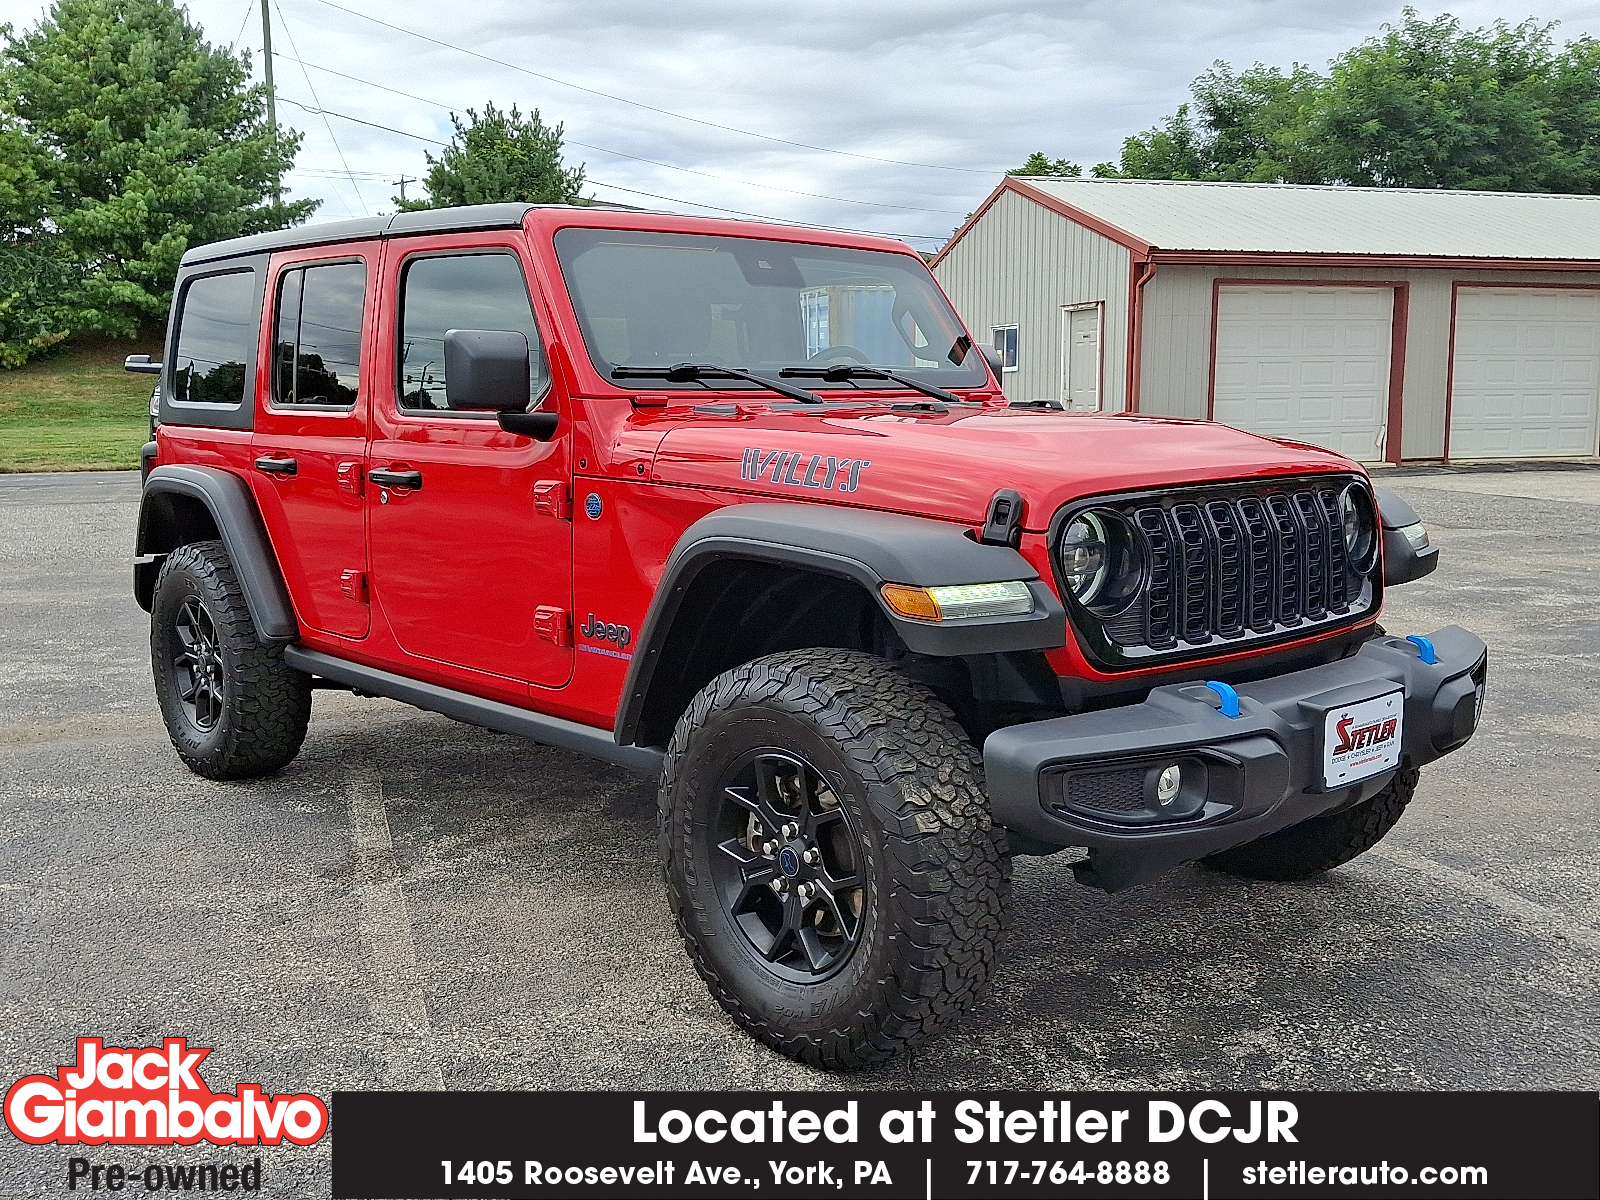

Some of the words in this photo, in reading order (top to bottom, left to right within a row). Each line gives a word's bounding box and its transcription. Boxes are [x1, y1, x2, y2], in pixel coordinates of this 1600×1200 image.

[741, 448, 871, 492] WILLYS
[581, 613, 631, 649] Jeep
[1333, 717, 1397, 756] STETLER
